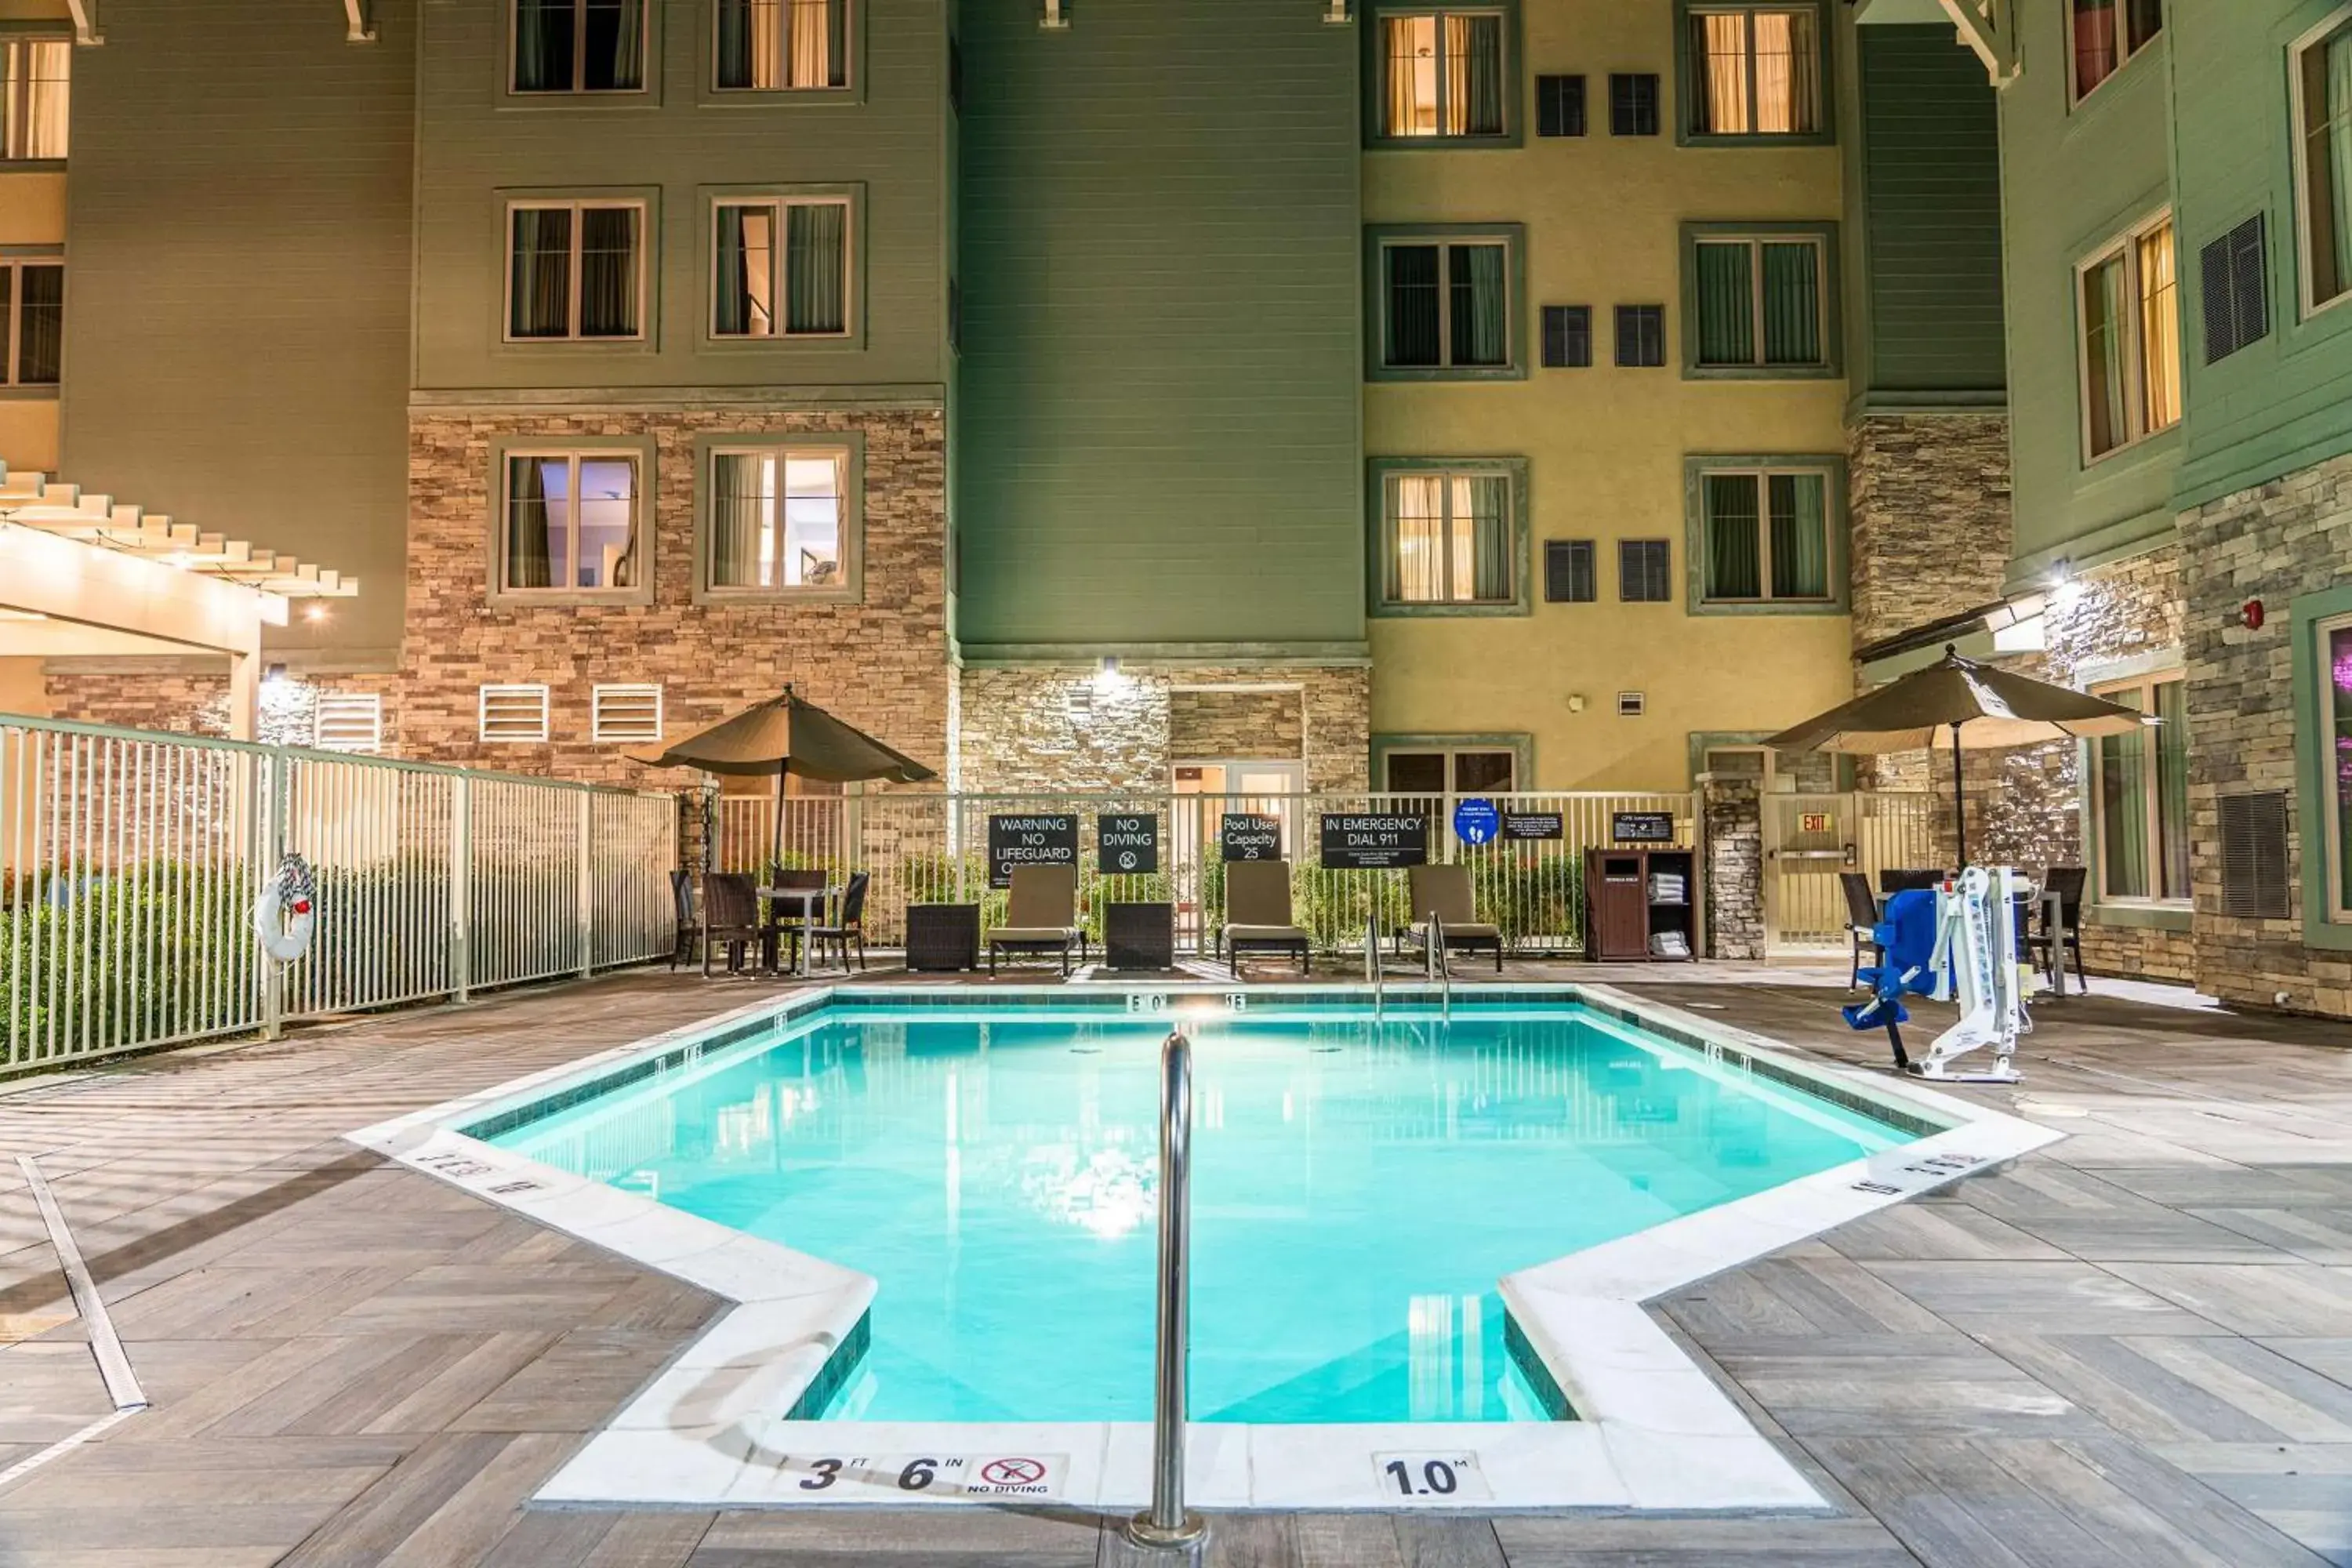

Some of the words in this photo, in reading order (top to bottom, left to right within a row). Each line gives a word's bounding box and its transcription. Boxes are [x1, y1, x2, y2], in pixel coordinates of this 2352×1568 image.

[999, 818, 1067, 831] WARNING
[1116, 819, 1139, 831] NO
[1224, 817, 1249, 831] Pool
[1252, 818, 1279, 831] User
[1325, 818, 1339, 830] IN
[1342, 818, 1421, 830] EMERGENCY
[1804, 815, 1825, 831] EXIT
[1022, 833, 1045, 846] NO
[1103, 833, 1152, 847] DIVING
[1225, 833, 1277, 848] Capacity
[1348, 833, 1377, 846] DIAL
[1379, 833, 1399, 846] 911
[996, 848, 1072, 860] LIFEGUARD
[1243, 848, 1259, 859] 25
[799, 1458, 844, 1490] 3
[850, 1457, 869, 1467] FT
[897, 1457, 939, 1491] 6
[945, 1457, 964, 1468] IN
[1385, 1460, 1457, 1495] 1.0
[967, 1485, 990, 1494] NO
[994, 1485, 1049, 1494] DIVING
